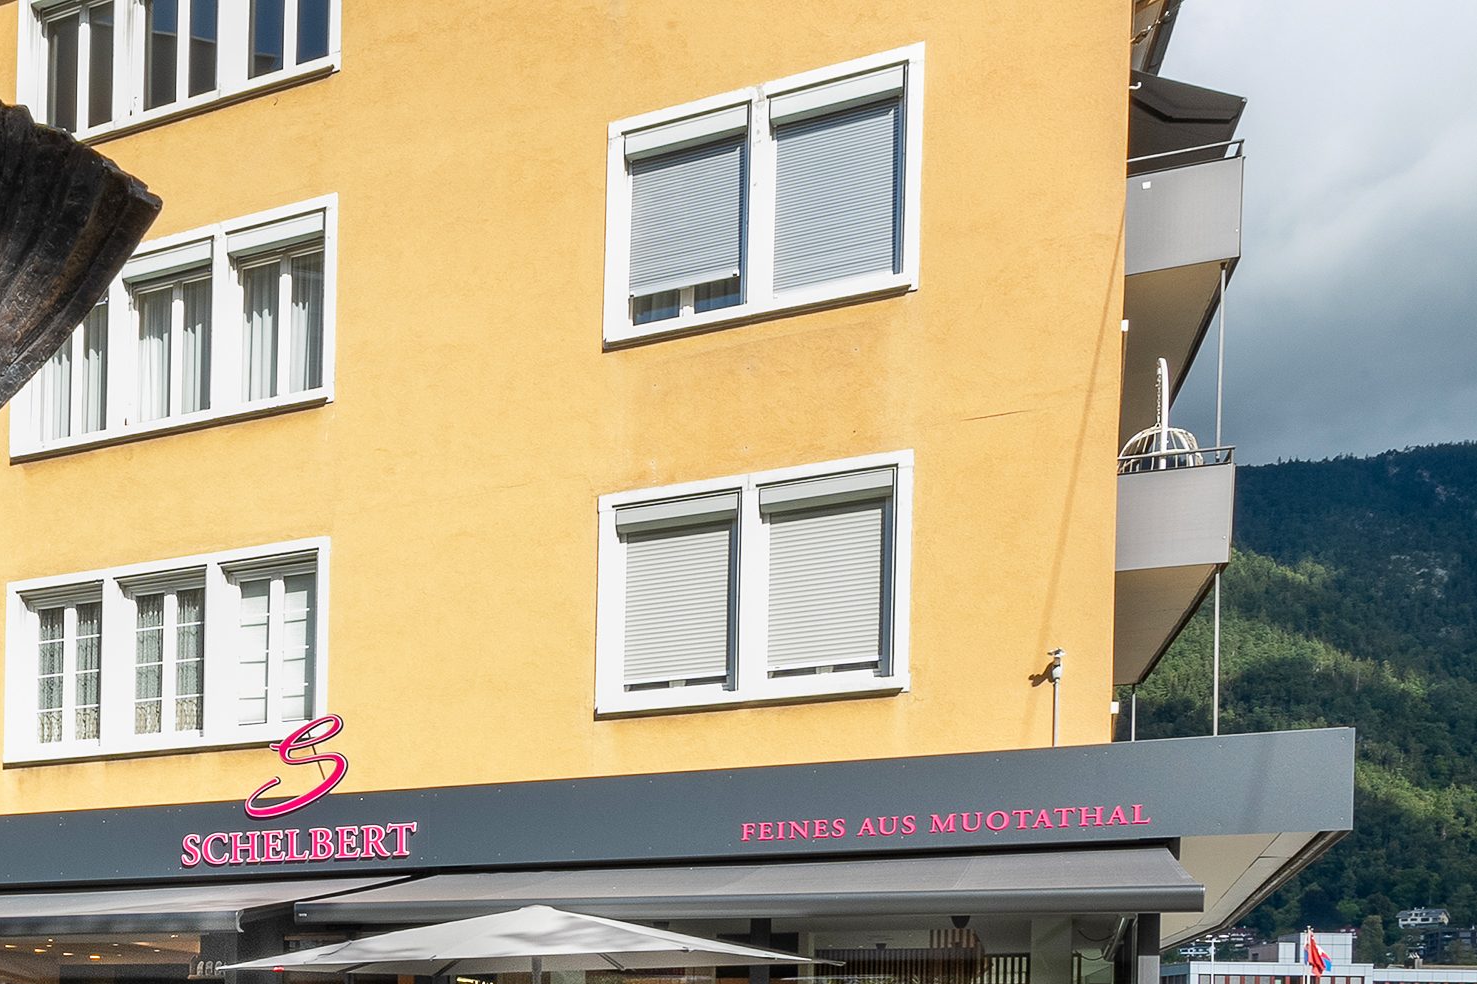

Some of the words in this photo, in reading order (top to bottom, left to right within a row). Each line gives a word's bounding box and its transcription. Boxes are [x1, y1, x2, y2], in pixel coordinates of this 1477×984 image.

[181, 821, 418, 867] SCHELBERT
[741, 818, 847, 842] FEINES
[857, 815, 917, 838] AUS
[929, 804, 1152, 834] MUOTATHAL
